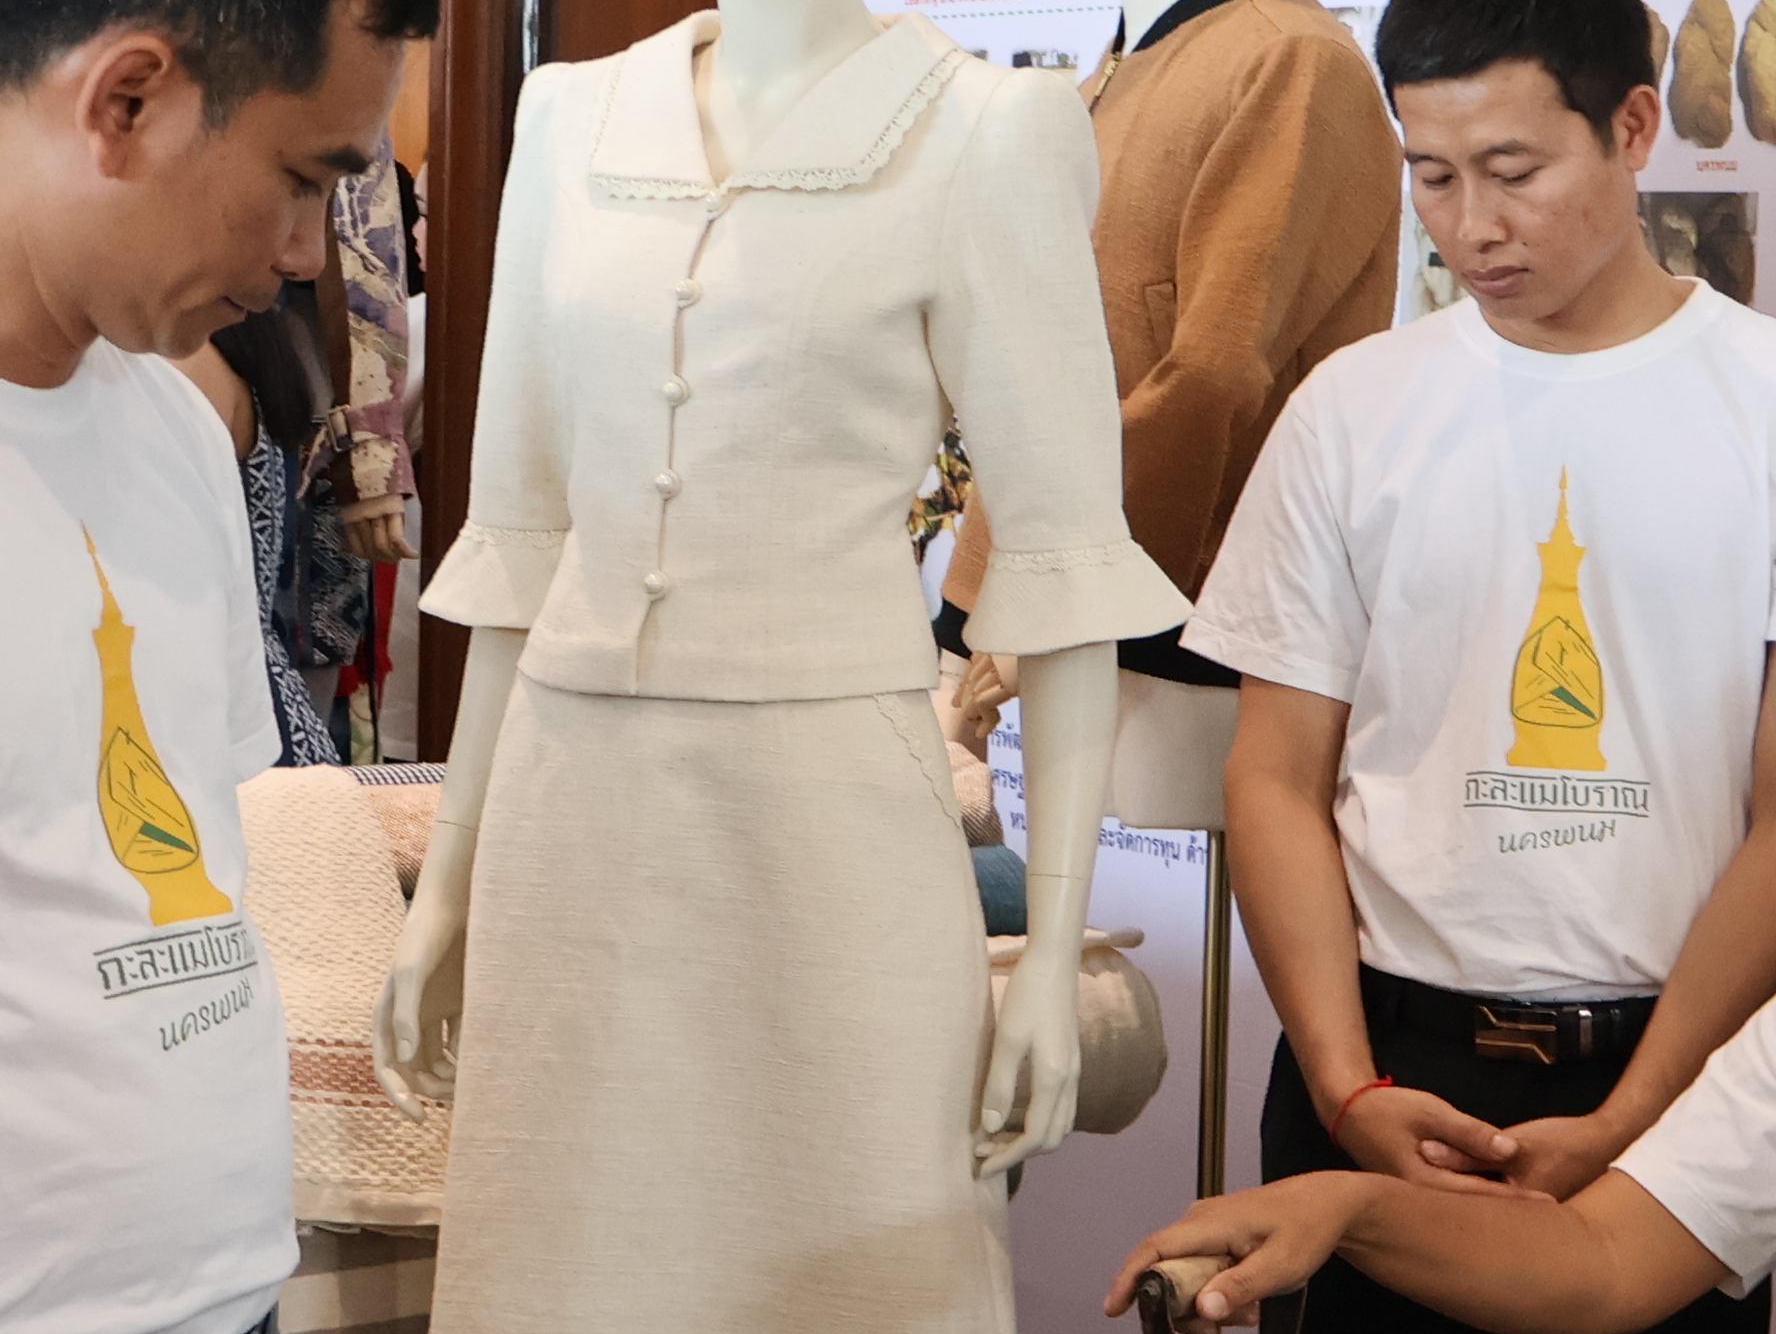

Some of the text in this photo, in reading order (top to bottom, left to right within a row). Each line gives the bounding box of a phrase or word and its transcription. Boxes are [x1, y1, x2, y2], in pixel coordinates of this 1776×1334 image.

[1464, 774, 1650, 813] กะละแมโบราณ
[1497, 818, 1618, 854] นครพนม
